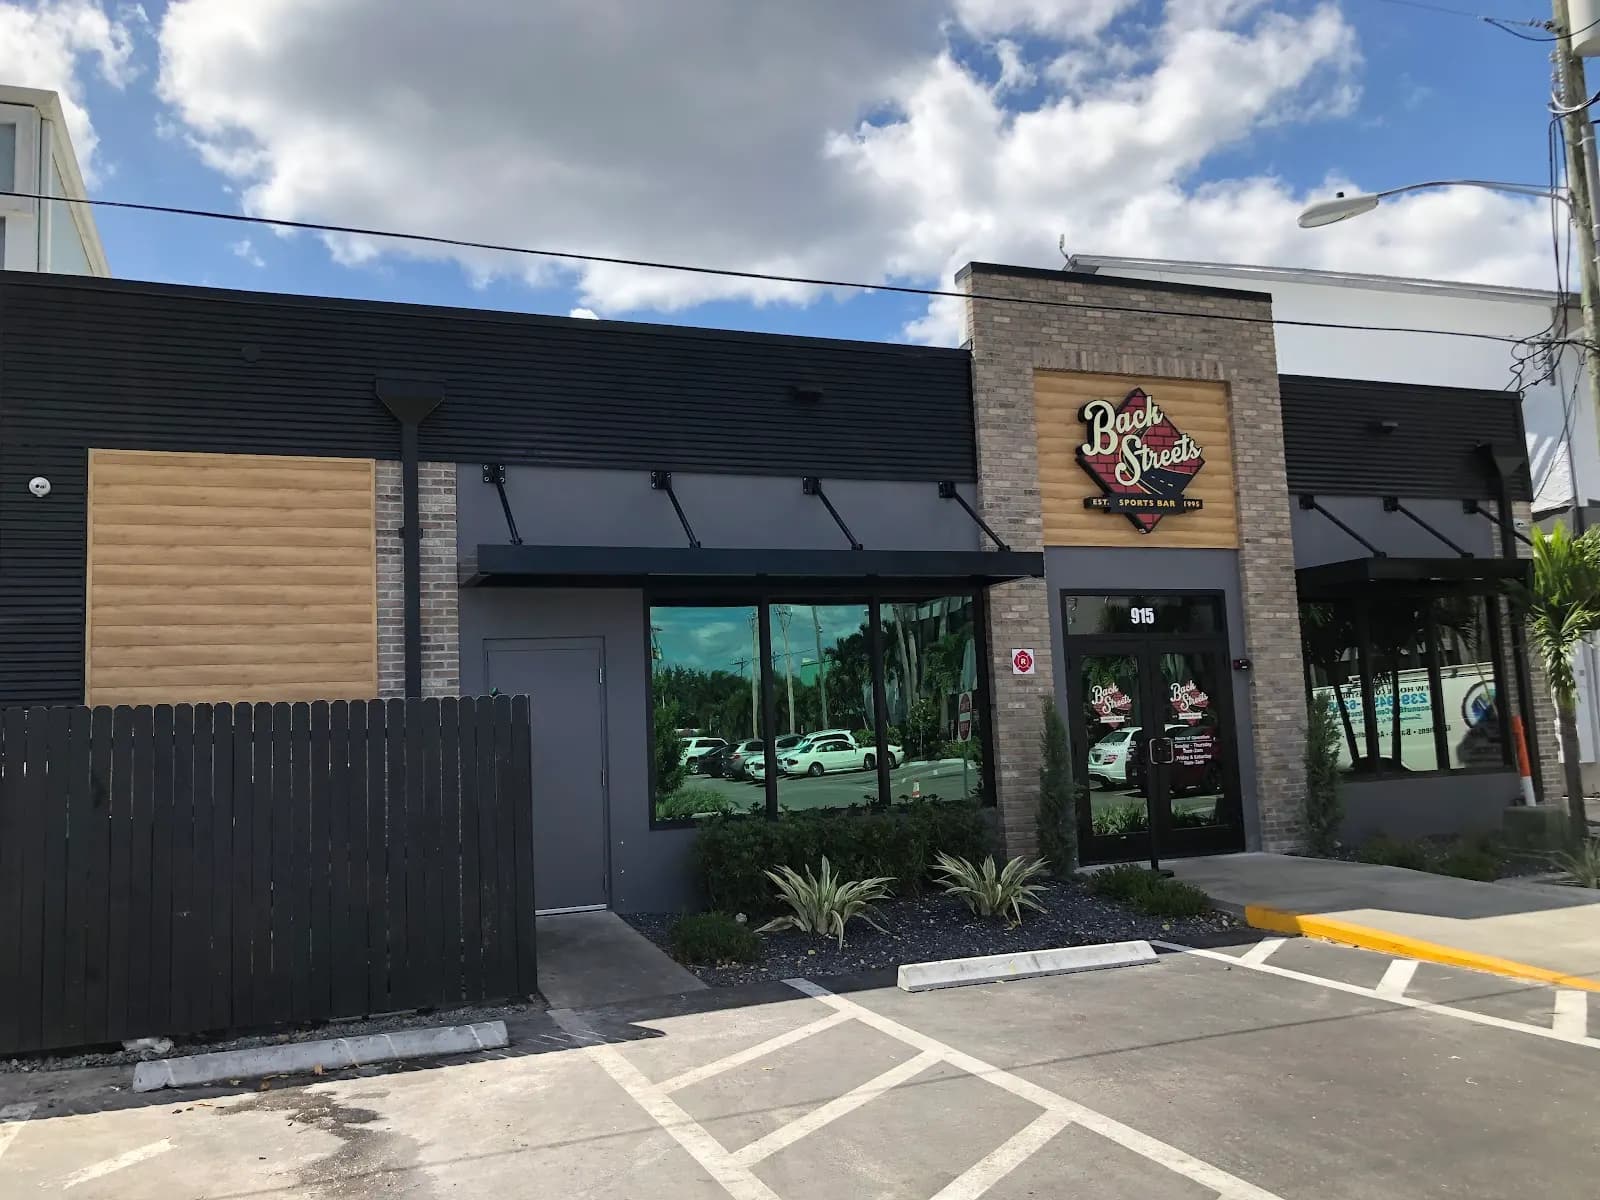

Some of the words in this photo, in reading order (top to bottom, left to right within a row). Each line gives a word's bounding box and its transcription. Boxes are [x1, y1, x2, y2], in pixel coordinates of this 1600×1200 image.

[1082, 396, 1164, 456] Back
[1115, 434, 1202, 486] Streets
[1092, 498, 1110, 506] EST.
[1119, 498, 1154, 507] SPORTS
[1157, 499, 1176, 508] BAR
[1183, 499, 1200, 508] 1995
[1130, 607, 1155, 624] 915
[1091, 682, 1119, 705] Back
[1169, 680, 1197, 702] Back
[1102, 694, 1132, 714] Streets
